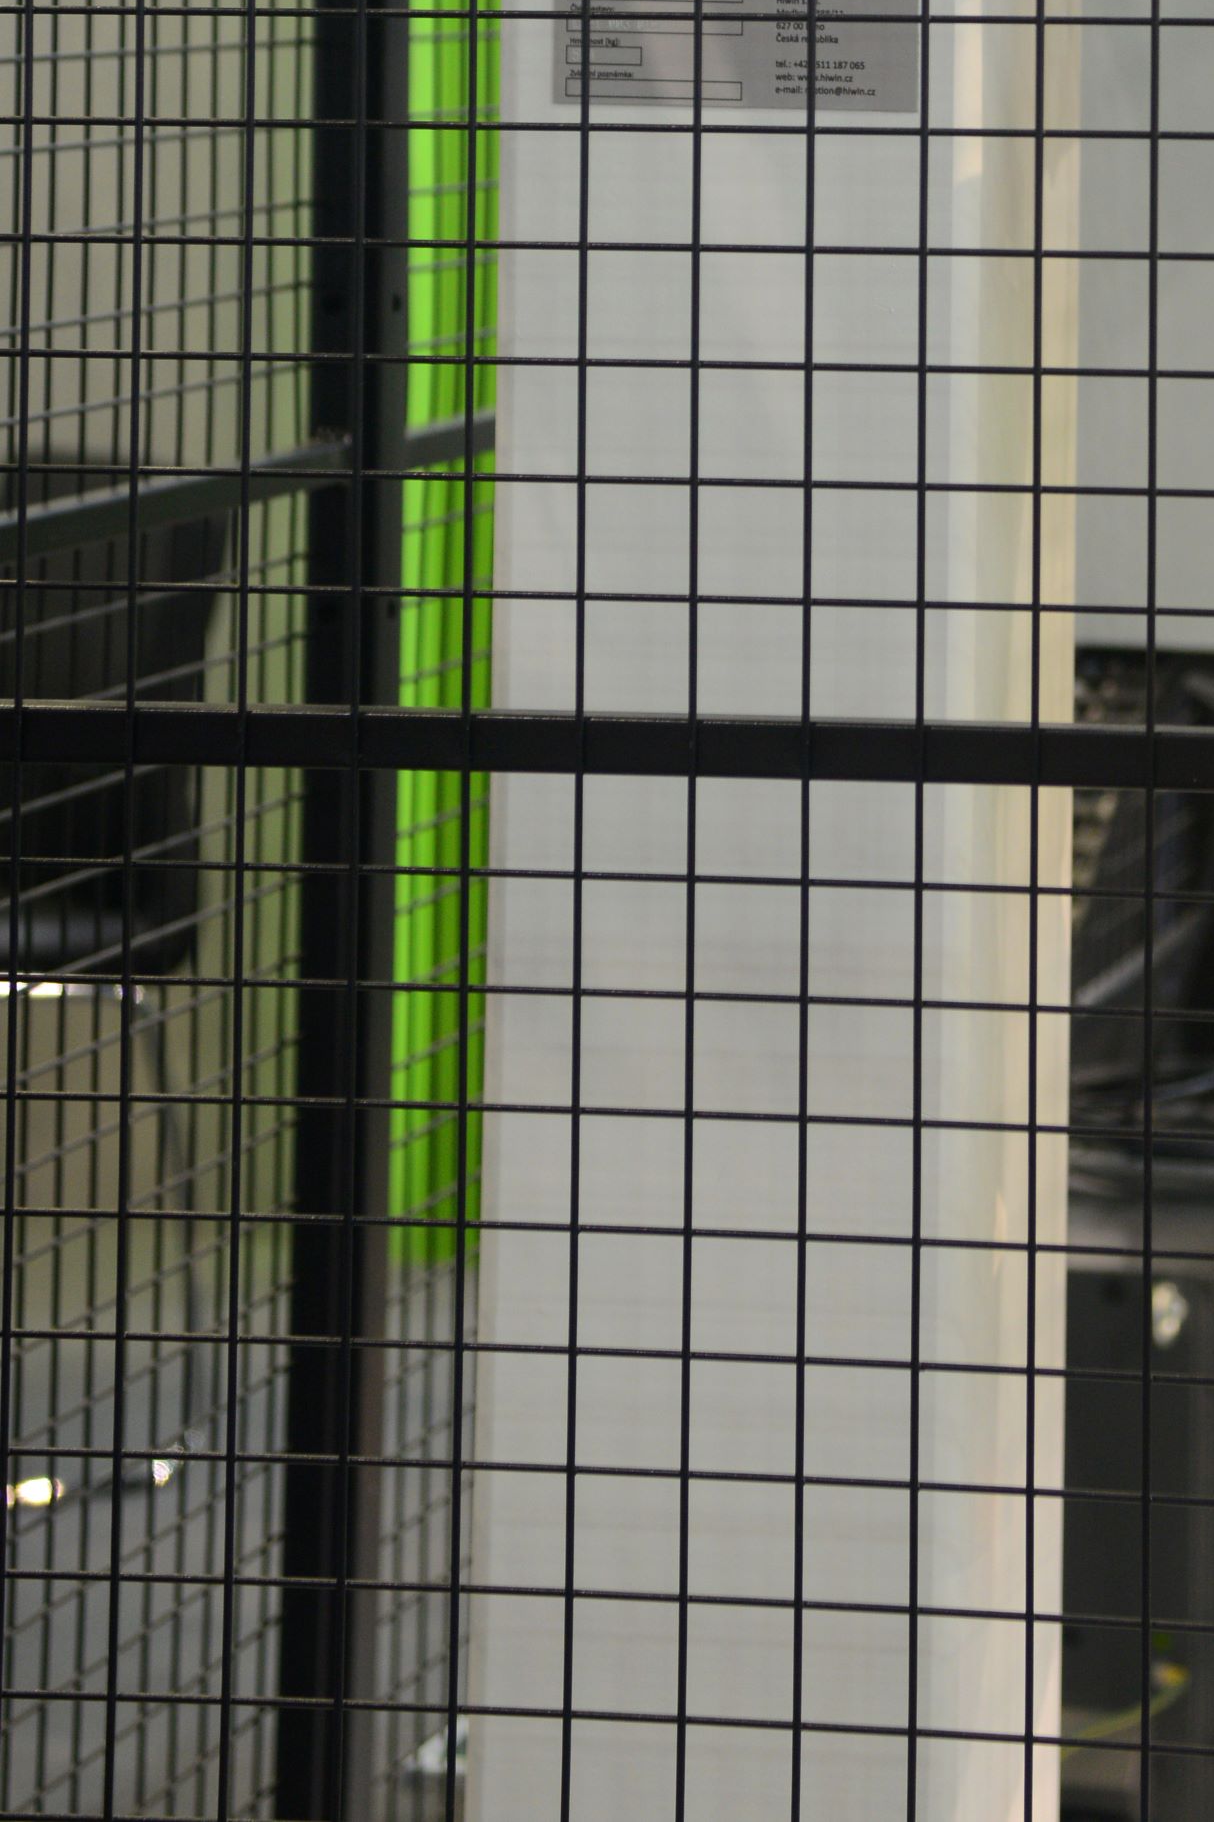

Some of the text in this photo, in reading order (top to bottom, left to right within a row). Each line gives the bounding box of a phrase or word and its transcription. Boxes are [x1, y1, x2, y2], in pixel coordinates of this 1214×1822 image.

[776, 22, 791, 30] 627
[793, 22, 804, 30] 00
[776, 33, 799, 43] Česká
[815, 61, 830, 69] 511
[833, 61, 848, 69] 187
[849, 62, 865, 70] 065
[798, 73, 853, 82] ww.hiwin.cz
[775, 85, 876, 96] e-mail: otion@hiwin.cz
